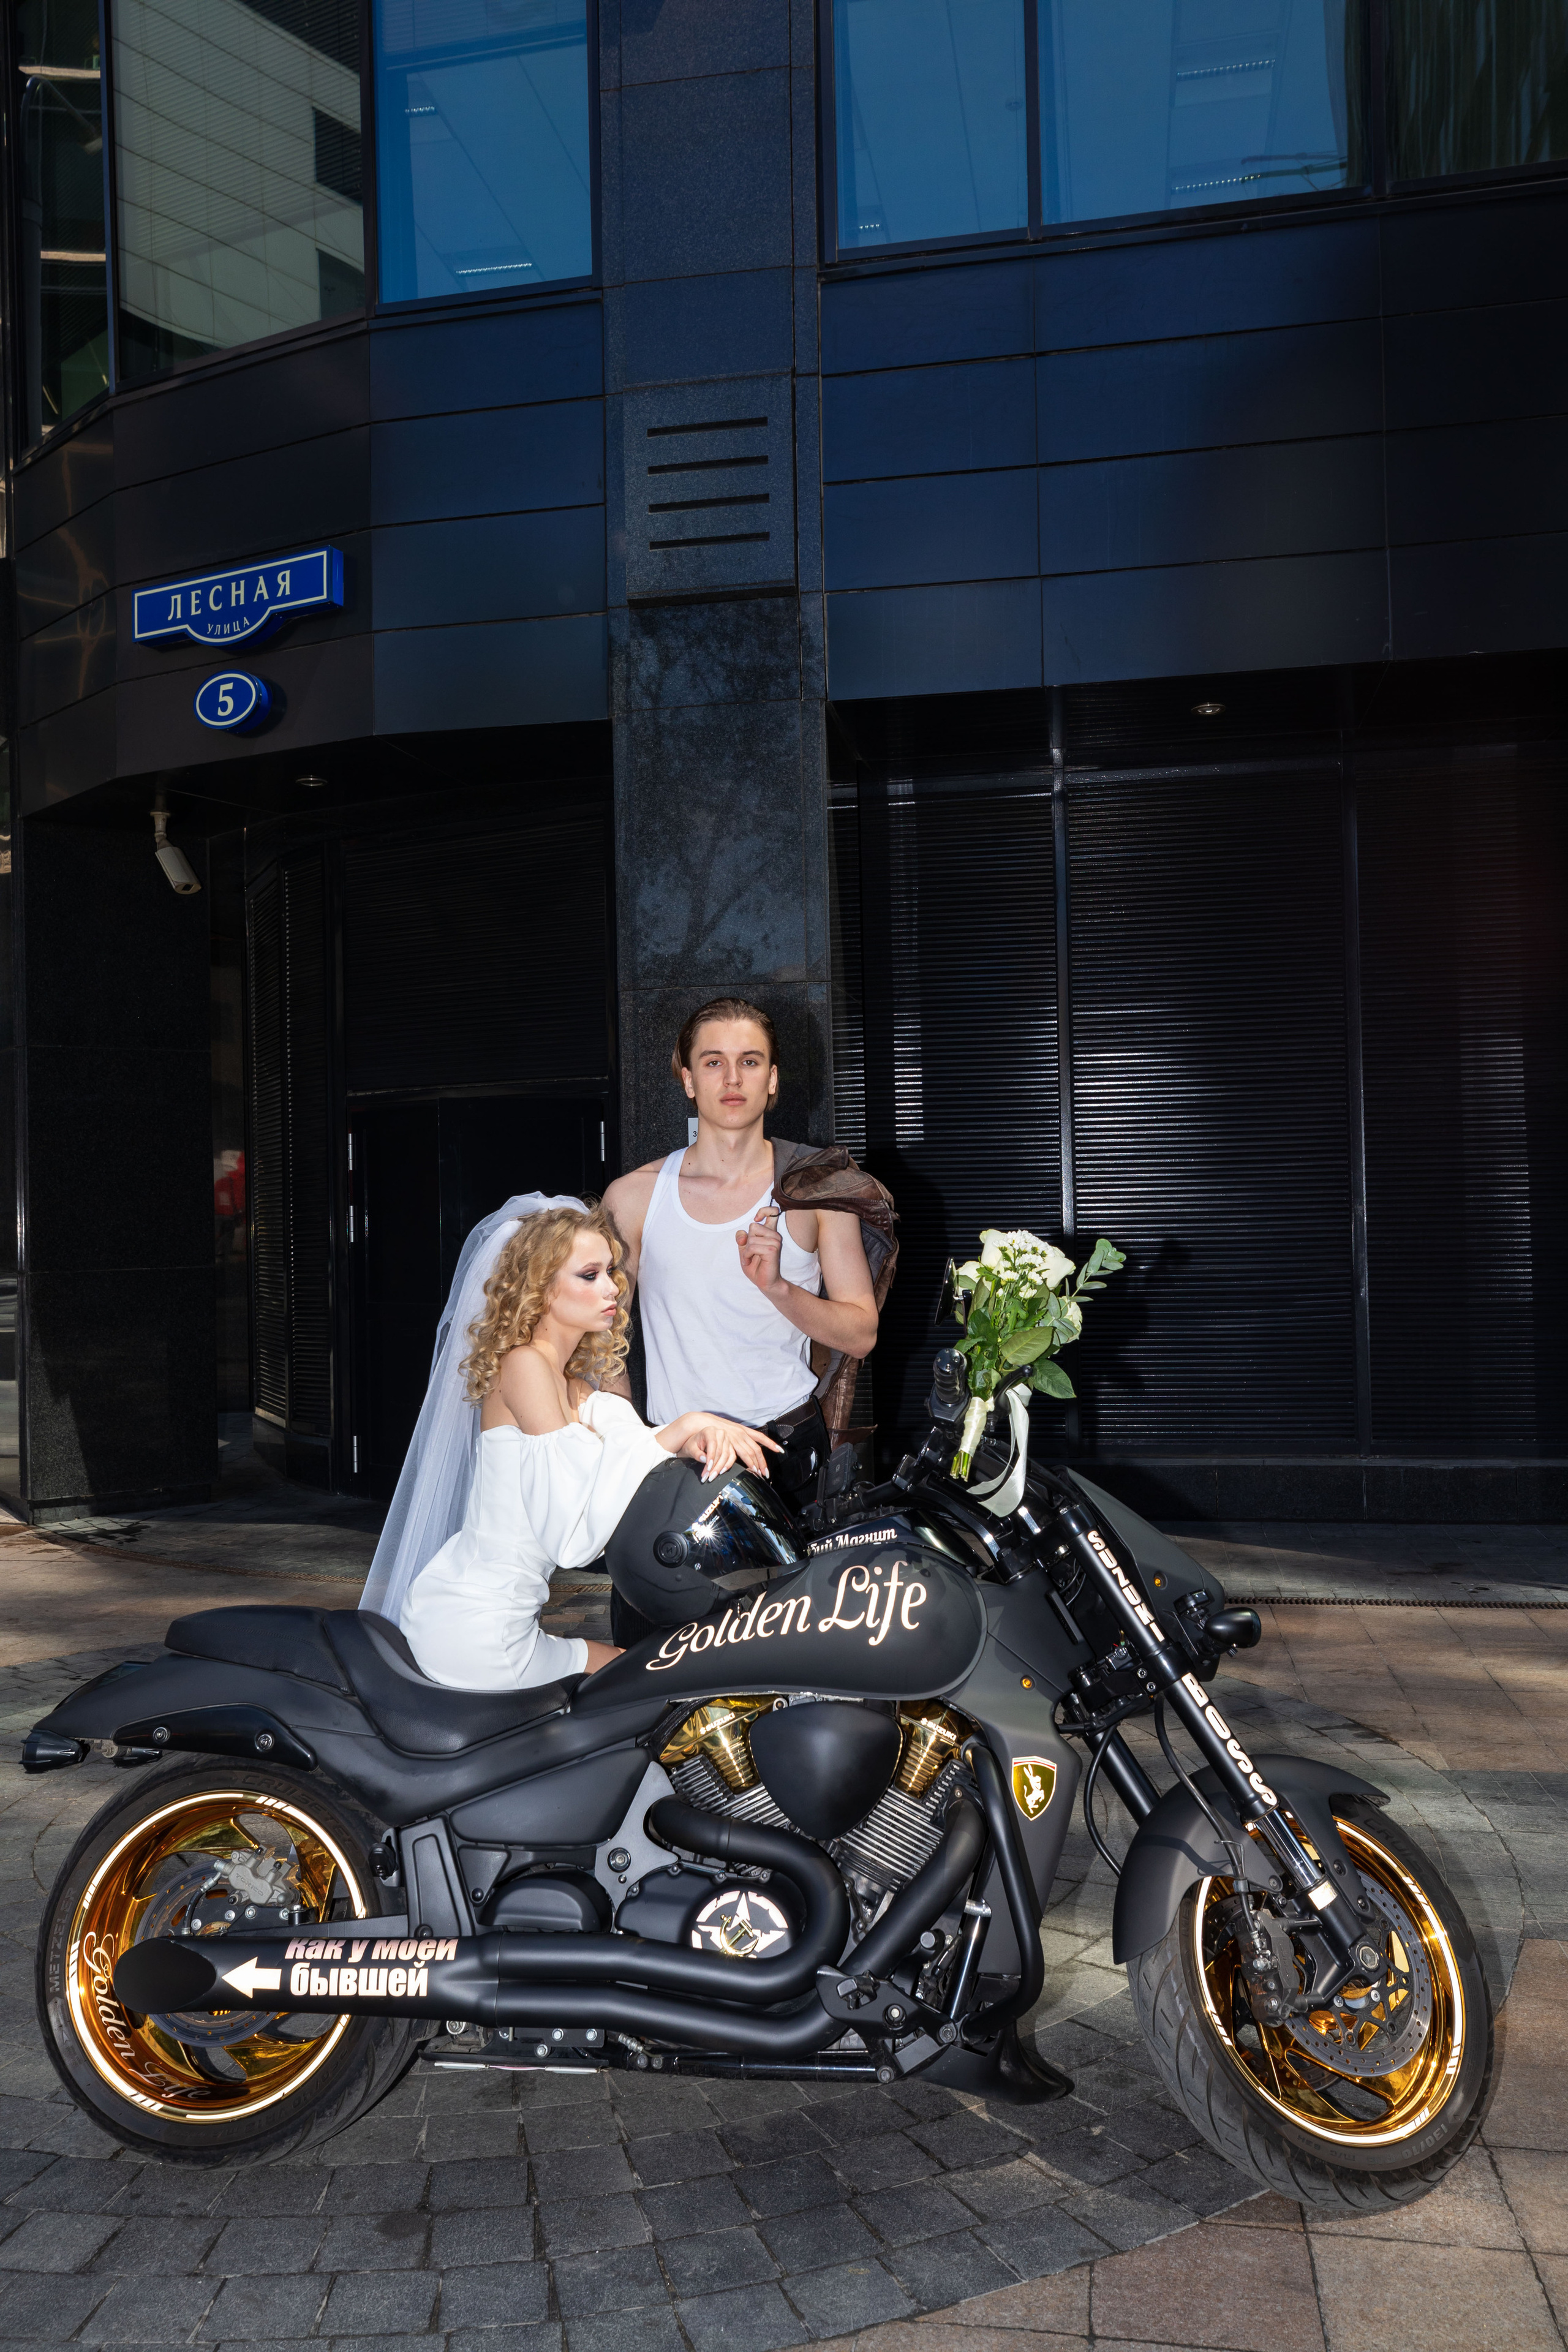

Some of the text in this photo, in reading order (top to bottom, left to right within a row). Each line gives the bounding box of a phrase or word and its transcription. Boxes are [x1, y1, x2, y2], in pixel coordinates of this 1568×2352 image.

[168, 570, 291, 620] ЛЕСНАЯ
[206, 617, 250, 635] УЛИЦА
[217, 682, 233, 717] 5
[835, 1528, 898, 1550] Магнит
[646, 1561, 927, 1671] Golden Life
[1088, 1531, 1277, 1806] SUZUKI BOSS
[706, 1712, 736, 1732] SUZUKI
[927, 1721, 957, 1741] SUZUKI
[49, 1887, 77, 1994] METZELER
[285, 1937, 347, 1959] Как
[348, 1939, 370, 1963] у
[290, 1960, 428, 1997] бывшей
[83, 1931, 211, 2099] Golden Life
[1402, 2124, 1449, 2159] 130/70
